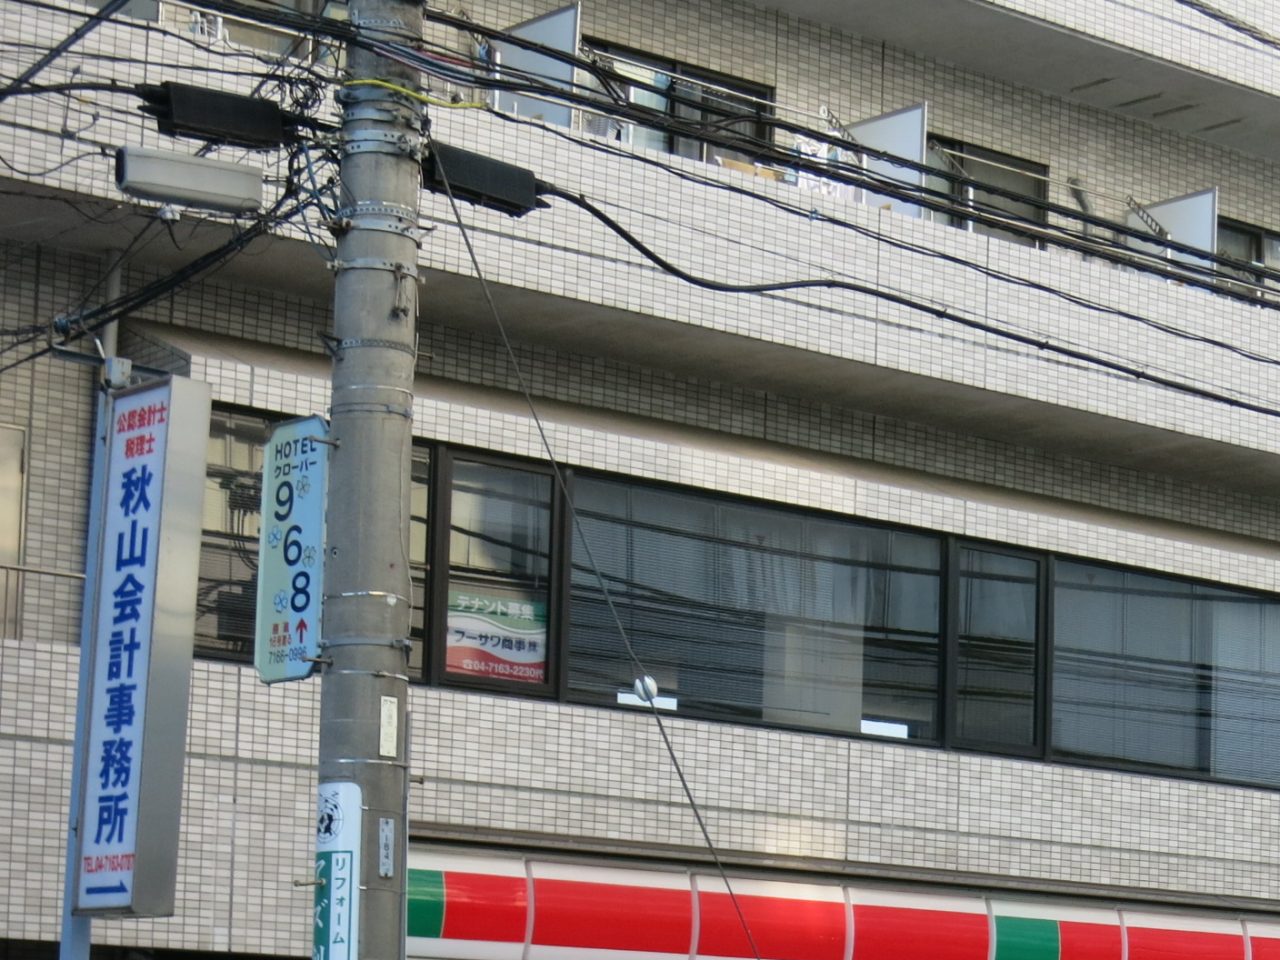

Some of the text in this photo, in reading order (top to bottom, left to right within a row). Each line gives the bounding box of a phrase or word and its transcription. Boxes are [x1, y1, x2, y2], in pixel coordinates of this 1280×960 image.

[117, 401, 167, 434] 公認会計士
[125, 432, 155, 459] 税理士
[275, 436, 317, 461] HOTEL
[275, 459, 317, 479] クローバー
[457, 595, 534, 620] テナント募集
[94, 466, 153, 845] 秋山会計事務所
[332, 857, 347, 944] リフォーム
